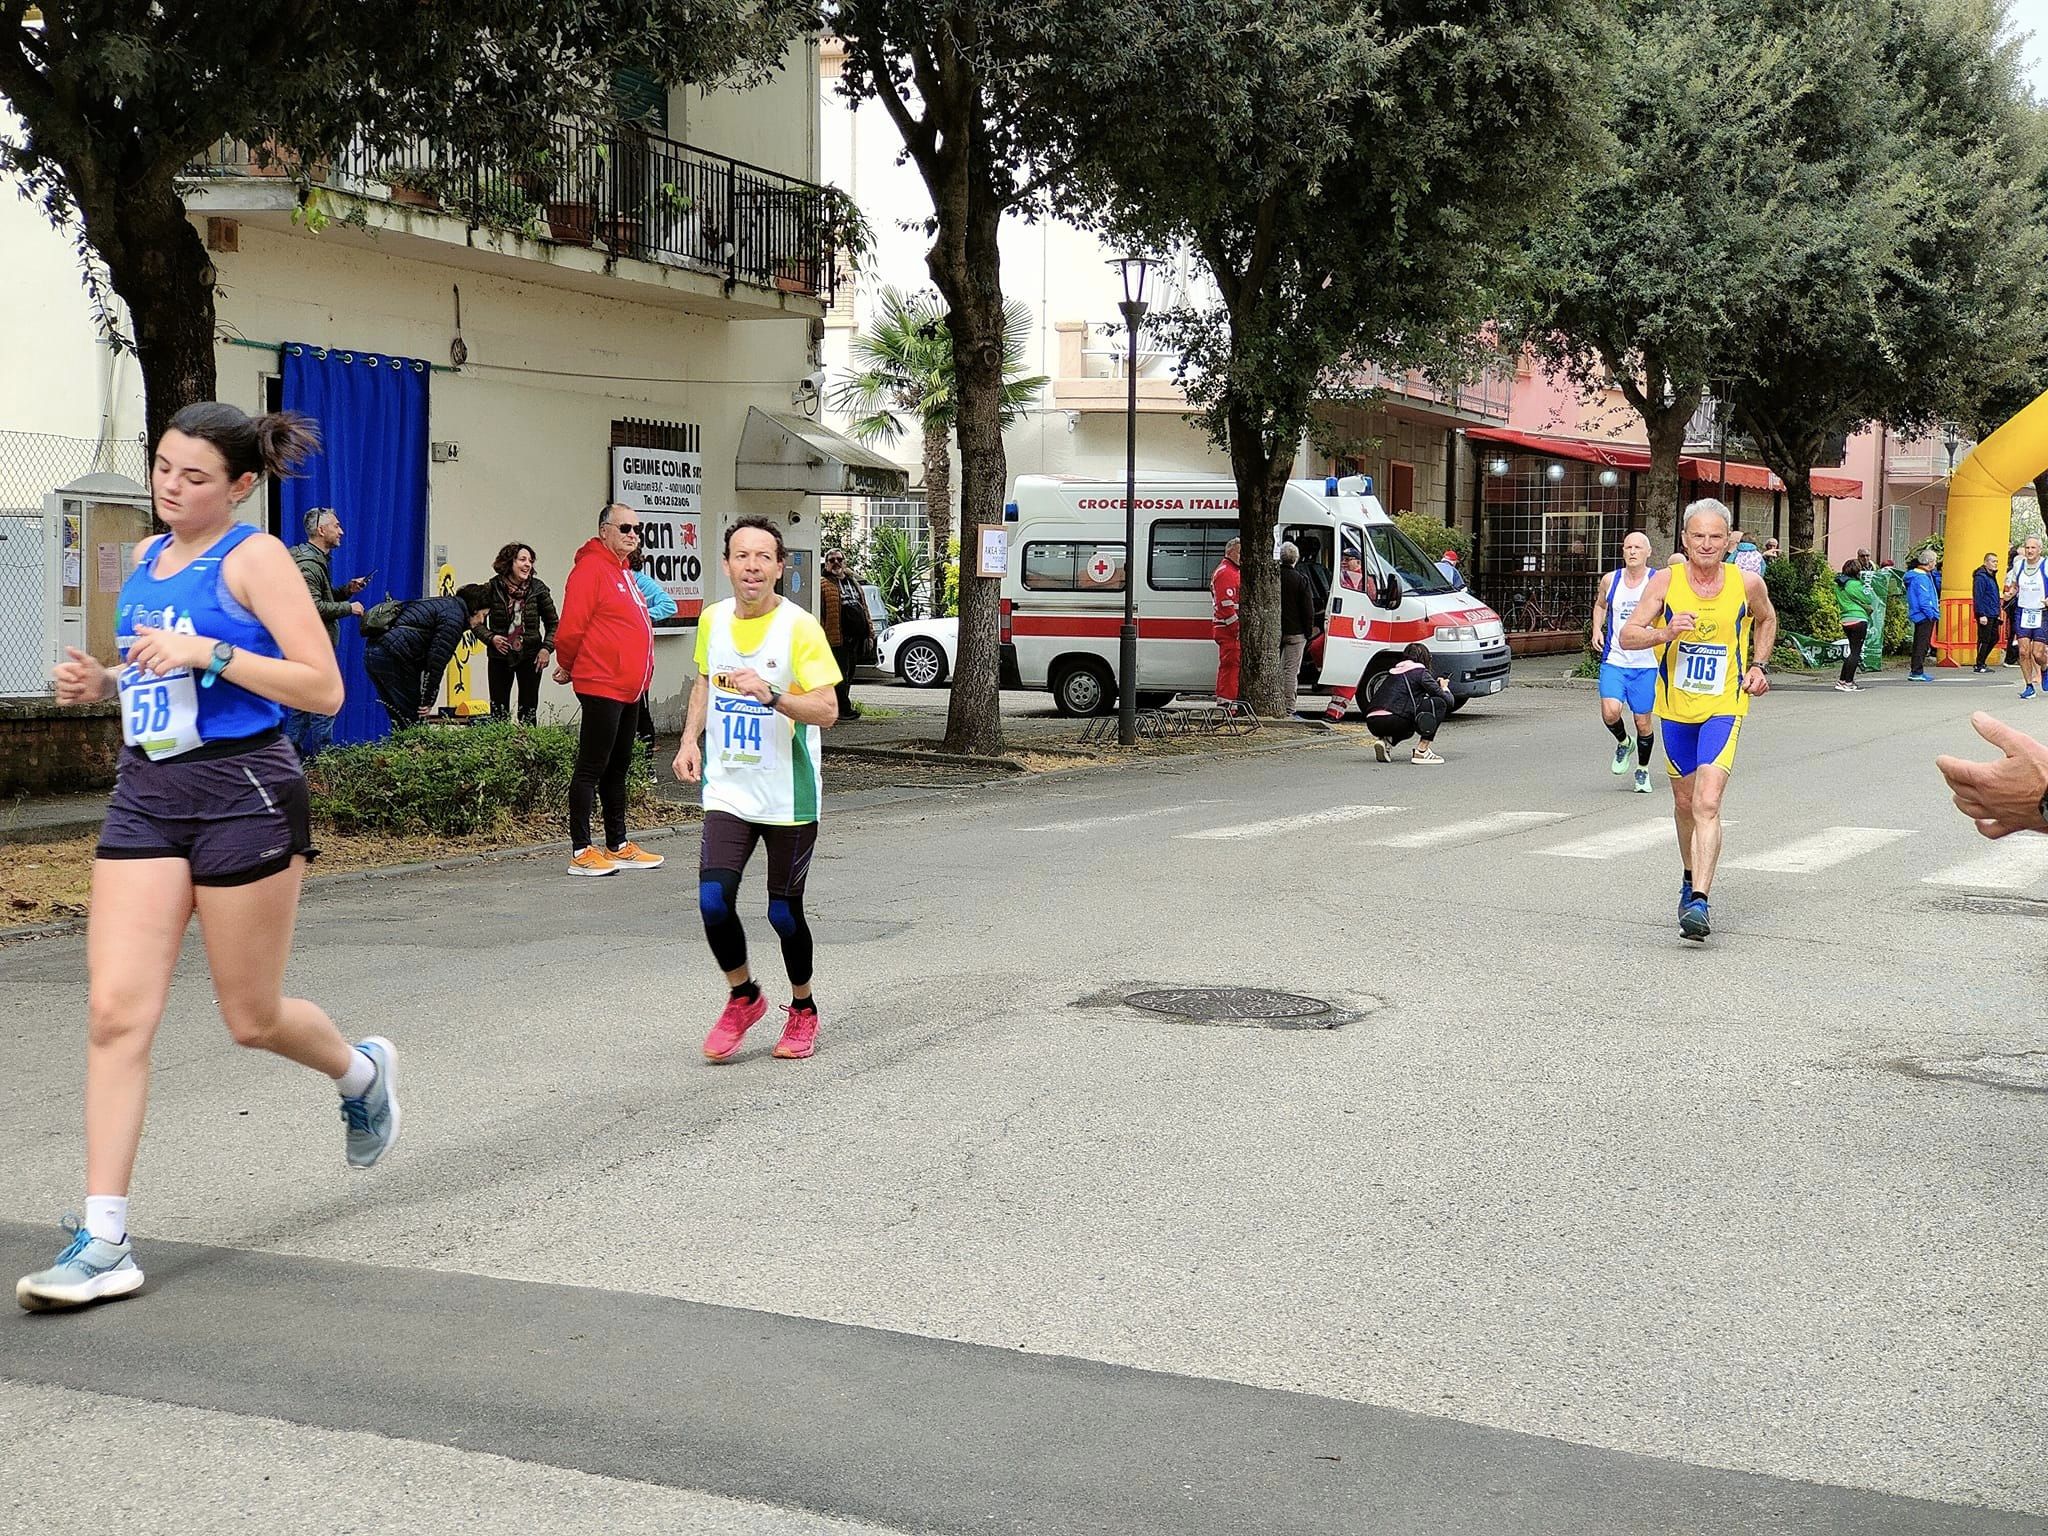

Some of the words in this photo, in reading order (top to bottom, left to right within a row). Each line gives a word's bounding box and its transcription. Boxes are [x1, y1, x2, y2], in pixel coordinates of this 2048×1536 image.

[1078, 499, 1127, 510] CROCE
[1133, 499, 1184, 510] ROSSA
[1686, 655, 1718, 681] 103
[132, 686, 171, 735] 58
[722, 715, 762, 751] 144
